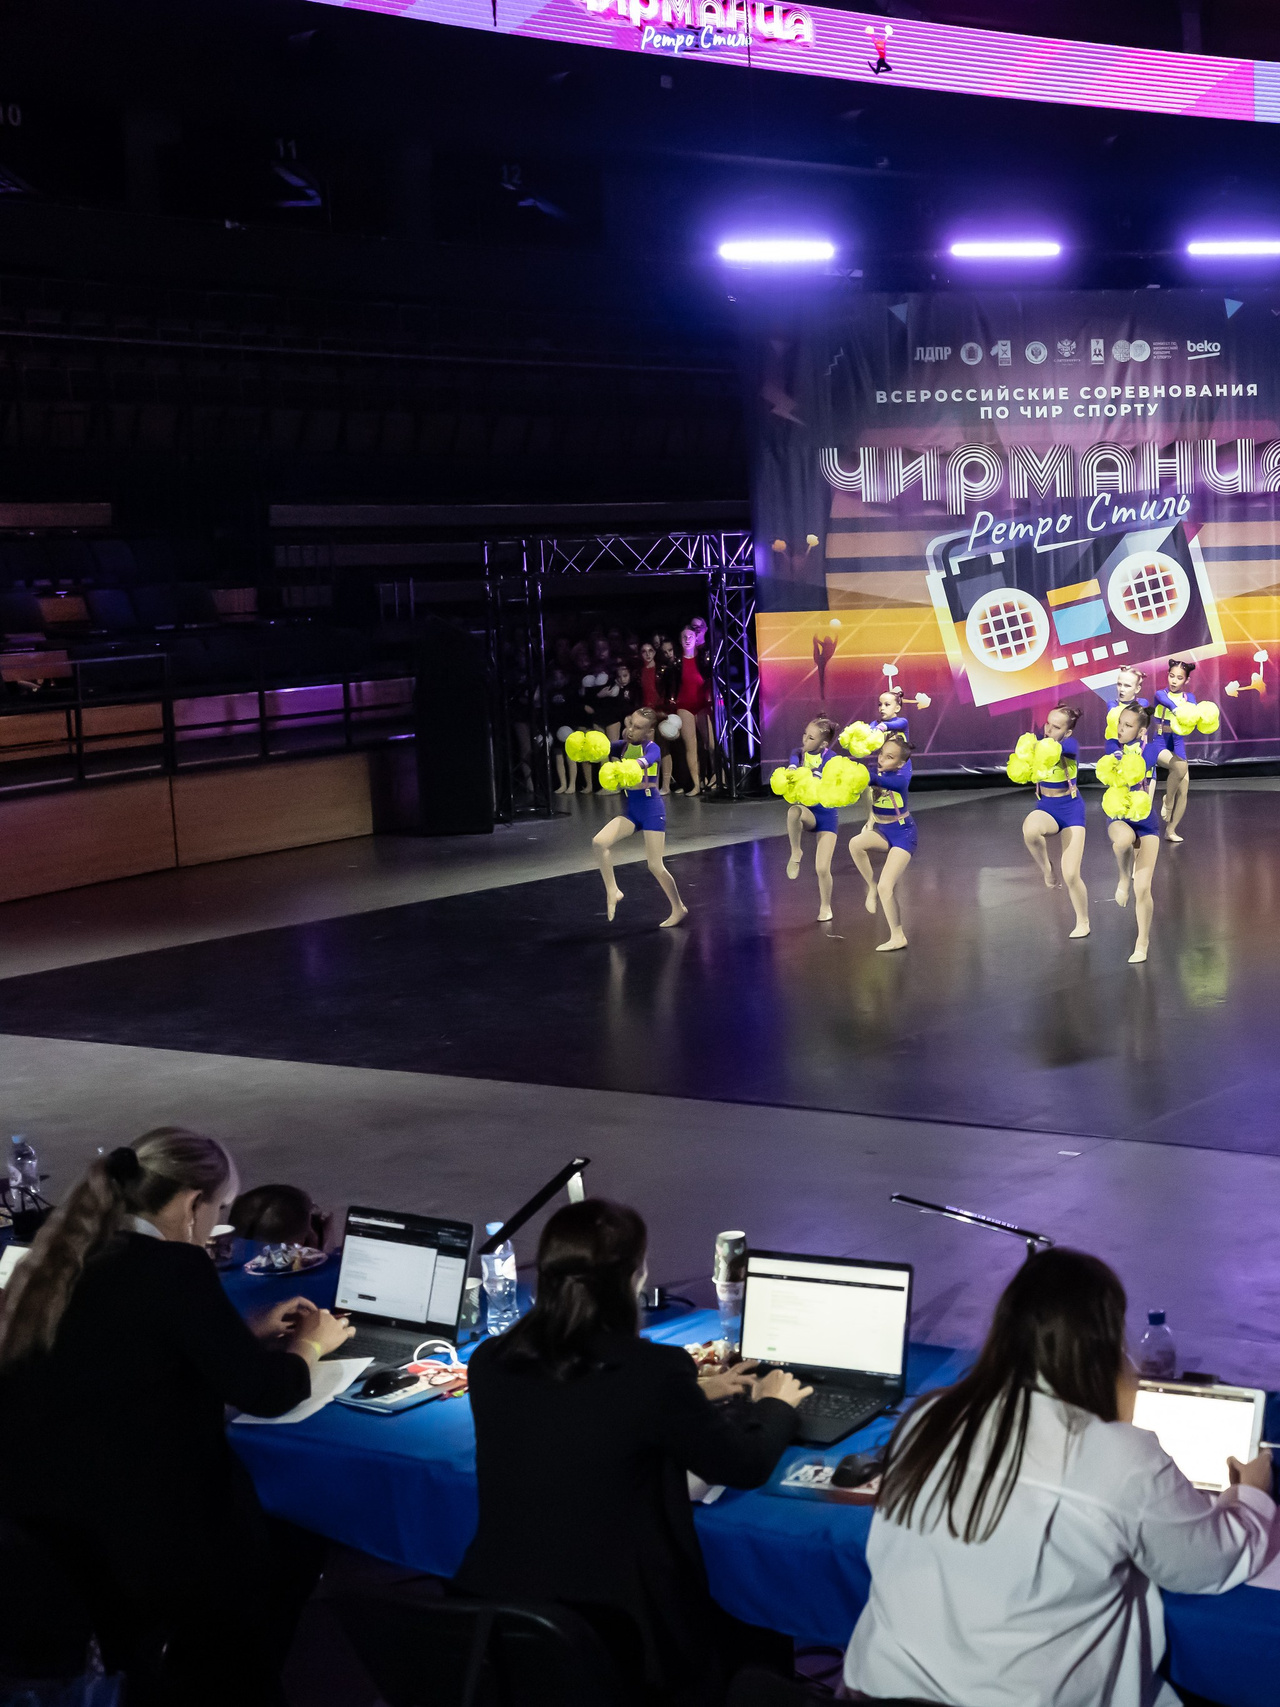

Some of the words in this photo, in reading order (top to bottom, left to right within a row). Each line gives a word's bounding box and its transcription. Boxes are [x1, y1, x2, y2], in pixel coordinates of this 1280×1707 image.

[641, 26, 694, 53] Ретро
[0, 103, 21, 126] 0
[914, 346, 952, 362] ЛДПР
[1187, 340, 1221, 352] beko
[876, 384, 1070, 404] ВСЕРОССИЙСКИЕ
[1079, 383, 1259, 401] СОРЕВНОВАНИЯ
[980, 406, 1010, 420] ПО
[1019, 404, 1064, 419] ЧИР
[1073, 403, 1160, 418] СПОРТУ
[968, 510, 1073, 552] Ретро
[1086, 492, 1191, 531] Стиль
